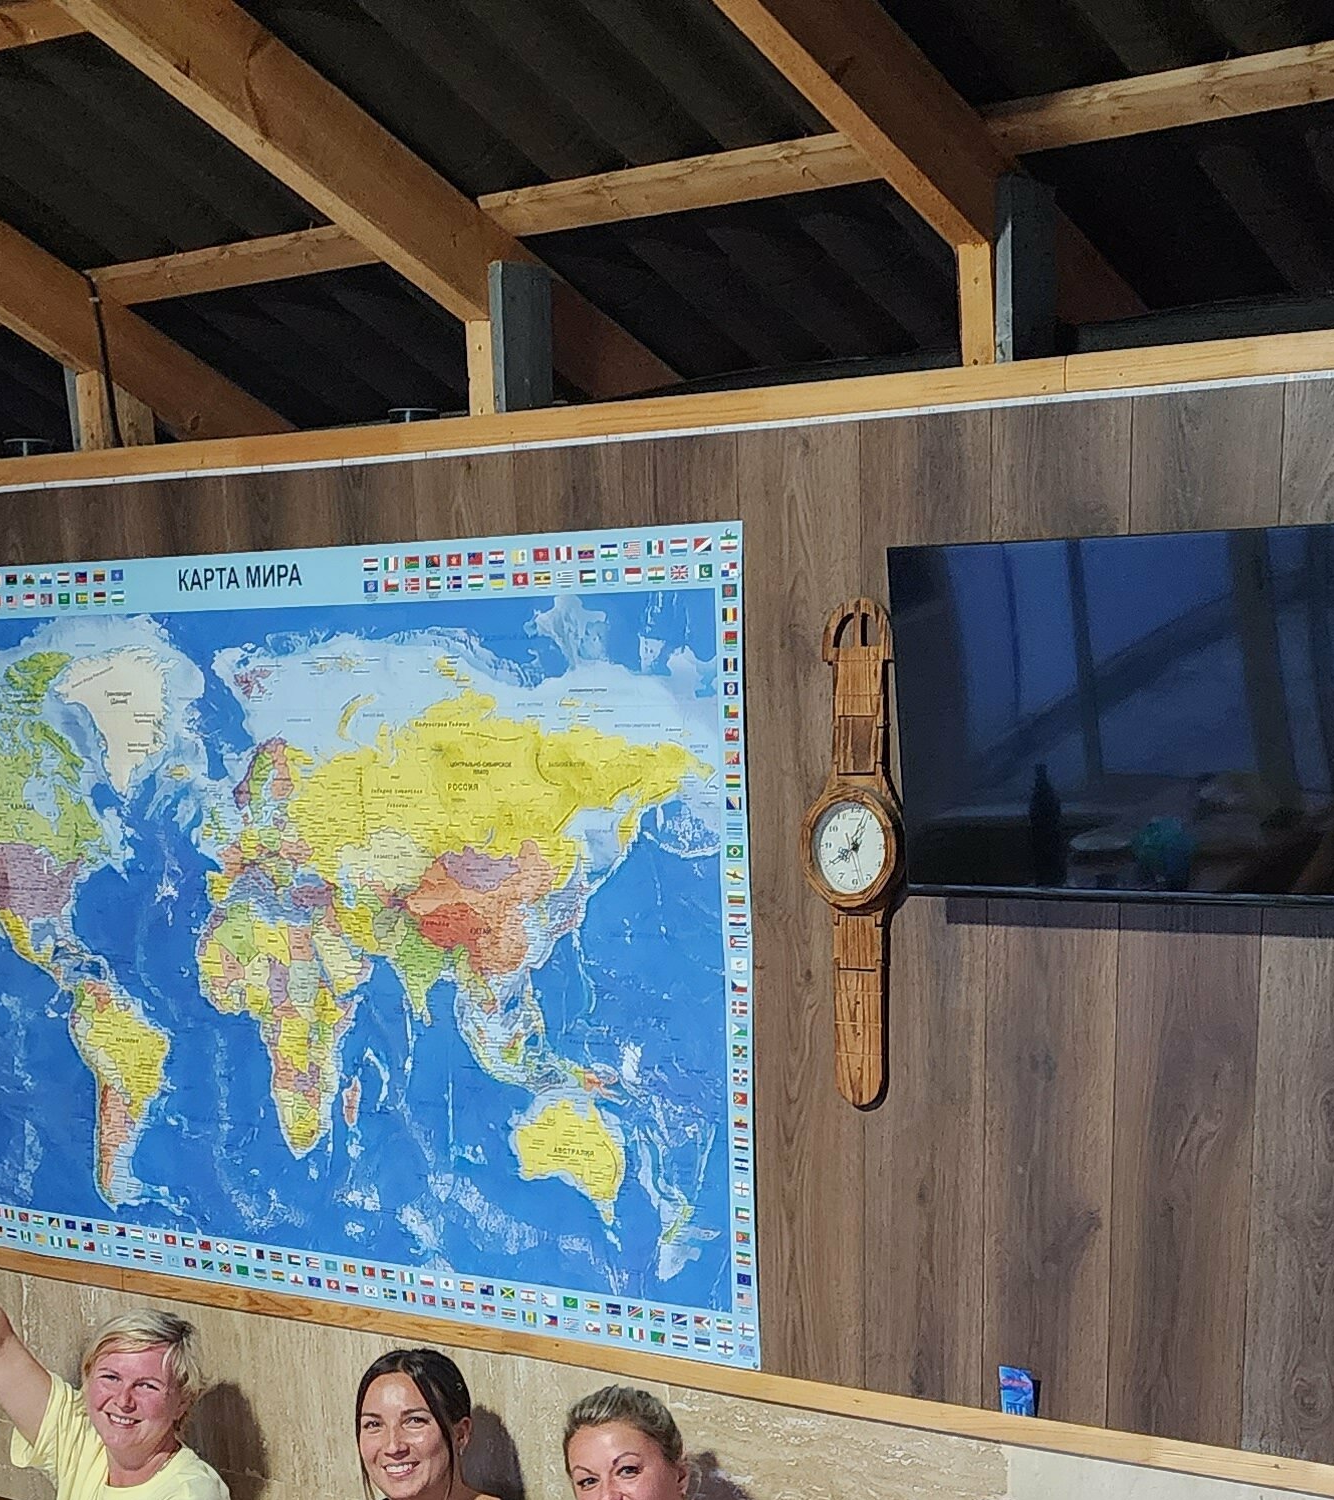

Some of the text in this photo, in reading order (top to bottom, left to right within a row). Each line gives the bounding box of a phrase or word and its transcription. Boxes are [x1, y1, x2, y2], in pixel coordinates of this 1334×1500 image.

[178, 563, 303, 592] КАРТА МИРА
[447, 783, 479, 791] РОССИЯ
